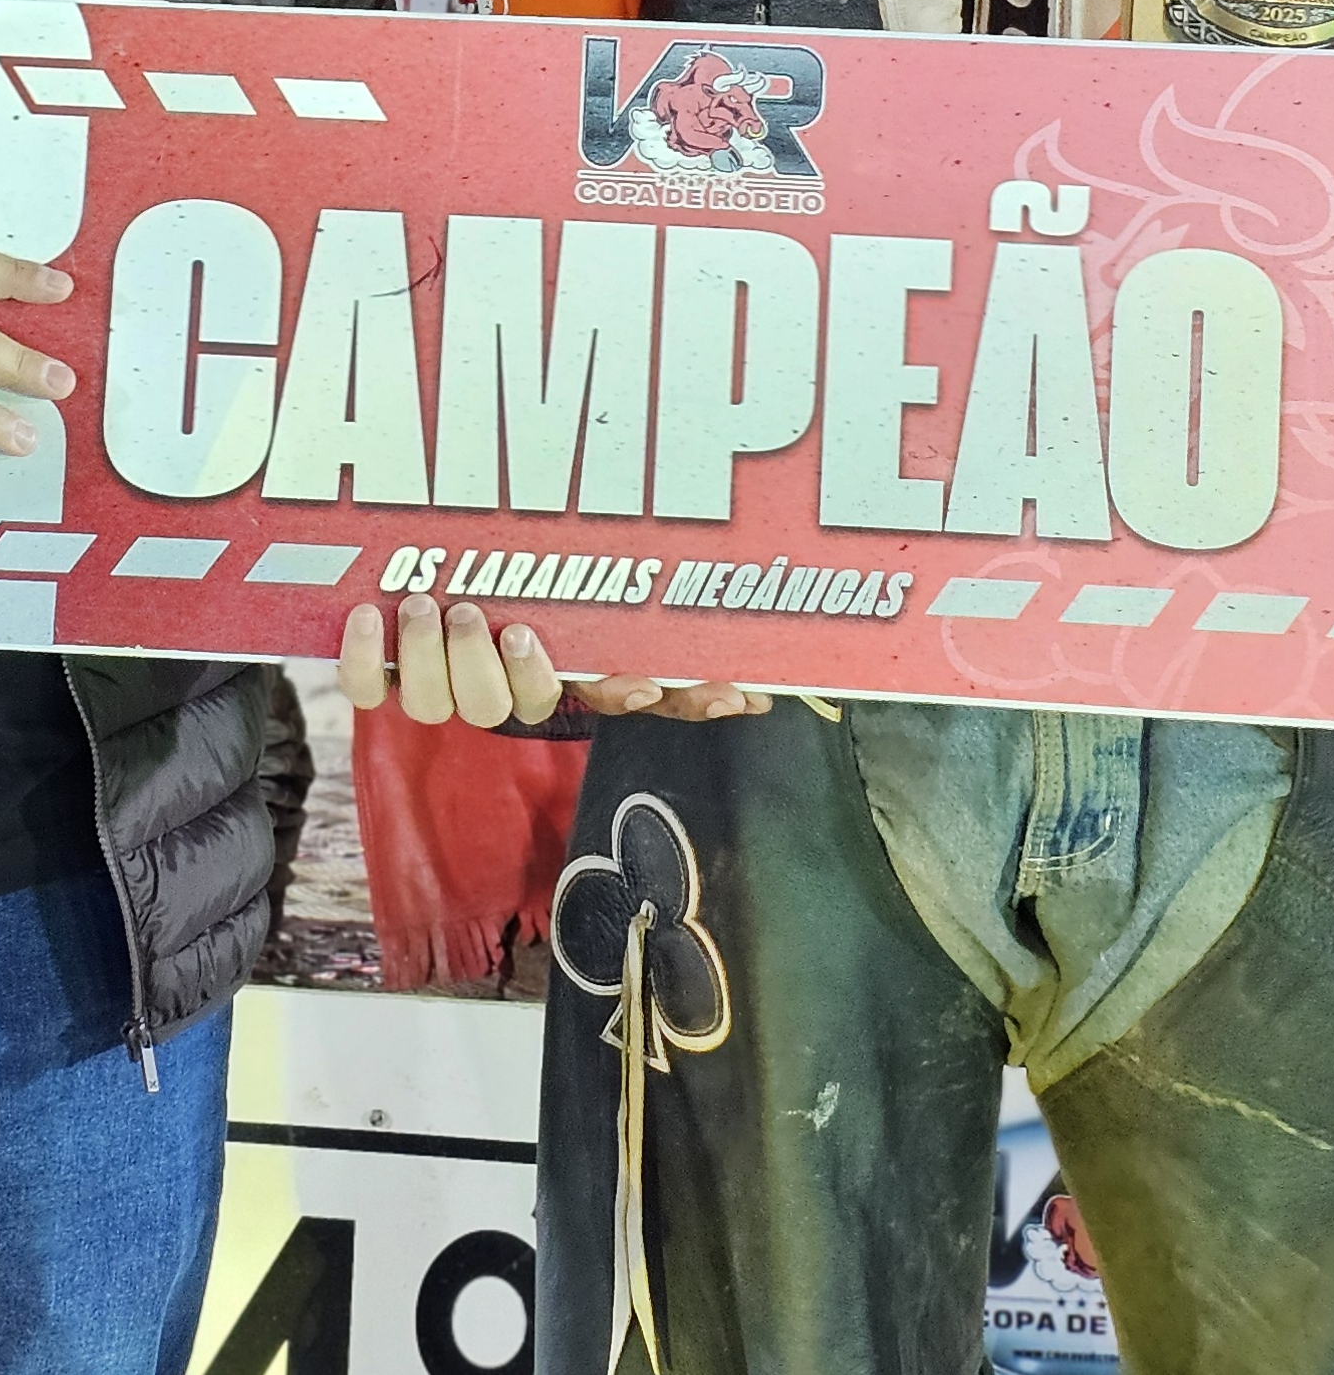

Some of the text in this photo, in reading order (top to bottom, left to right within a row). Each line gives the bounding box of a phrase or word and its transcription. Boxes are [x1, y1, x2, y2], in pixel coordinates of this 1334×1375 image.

[1258, 5, 1308, 24] 2025
[576, 182, 824, 214] COPA DE RODEIO
[103, 180, 1286, 552] CAMPEÃO
[378, 544, 915, 618] OS LARANJAS MECÂNICAS
[1067, 1313, 1108, 1336] DE
